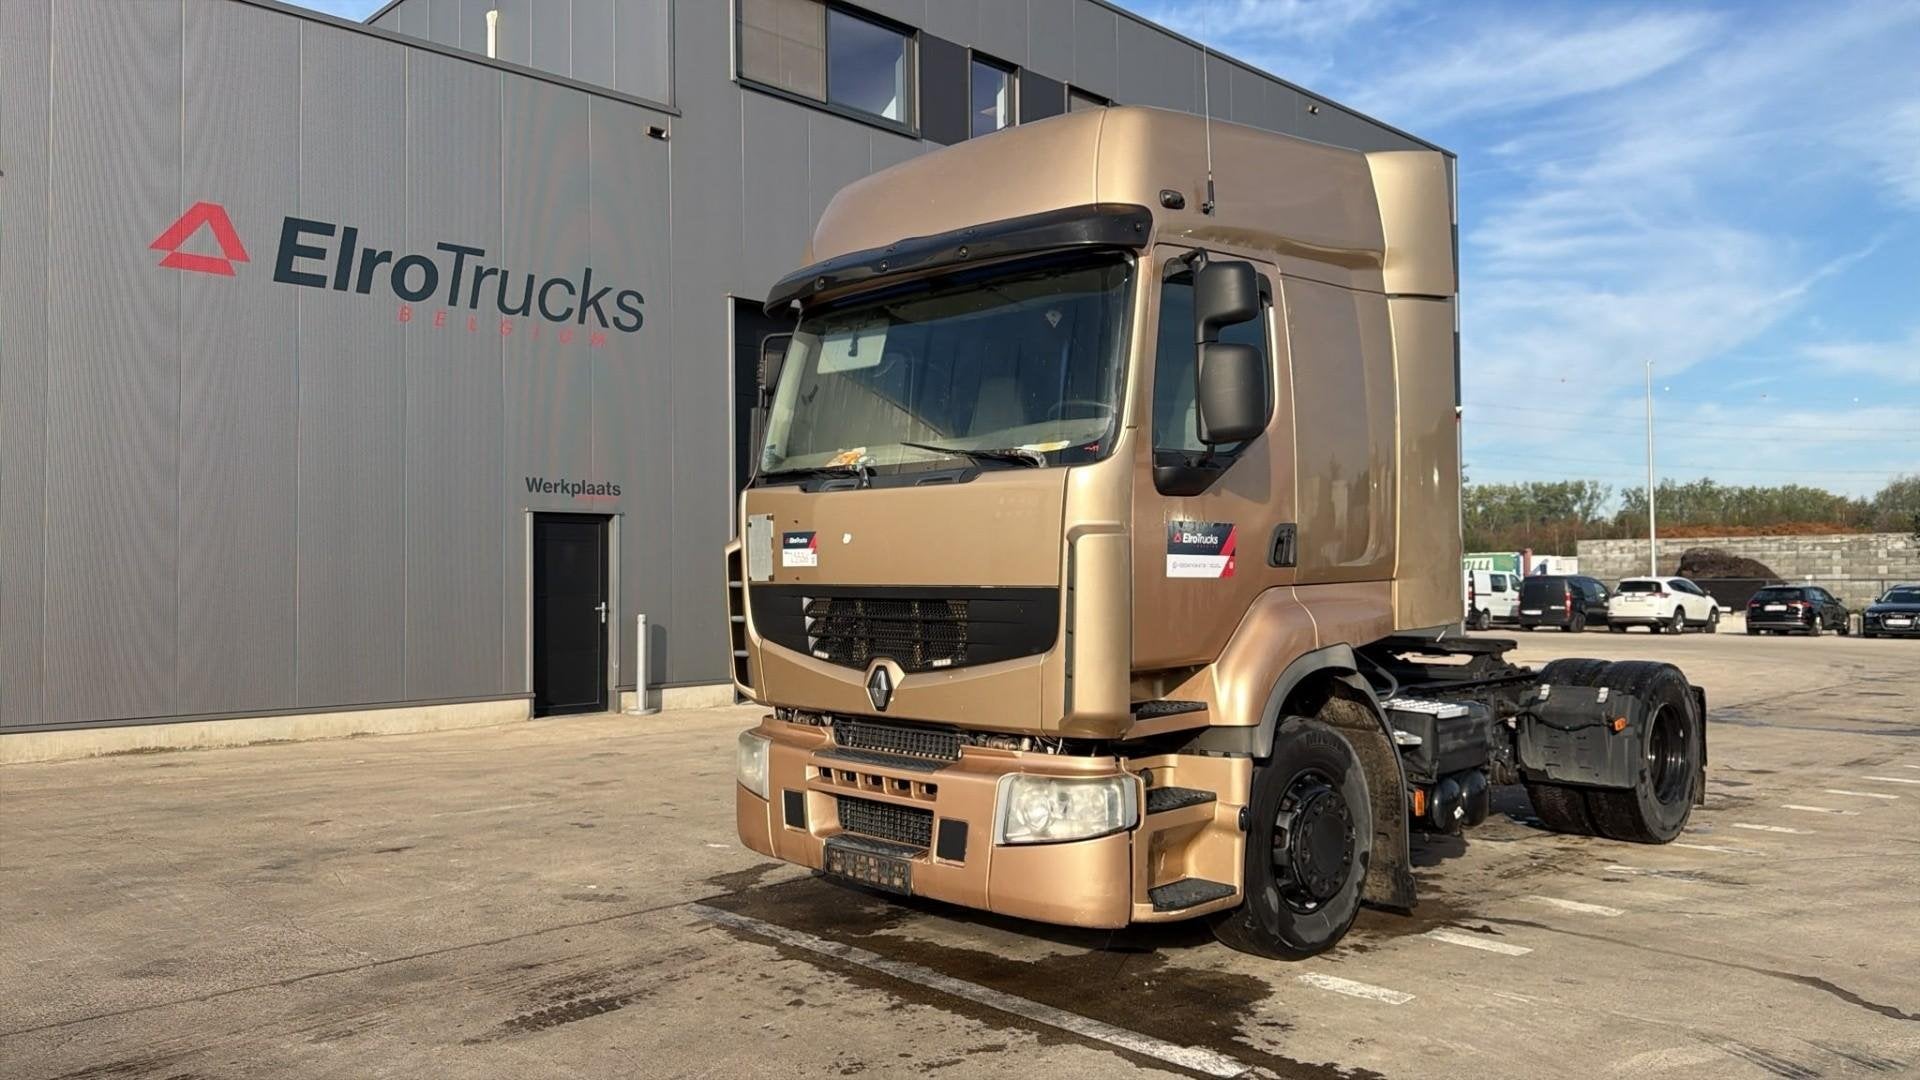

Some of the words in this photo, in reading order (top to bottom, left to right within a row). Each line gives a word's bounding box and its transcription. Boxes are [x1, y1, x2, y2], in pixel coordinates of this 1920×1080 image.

[273, 216, 645, 334] ElroTrucks
[397, 304, 608, 347] BELGIUM
[525, 477, 622, 498] Werkplaats
